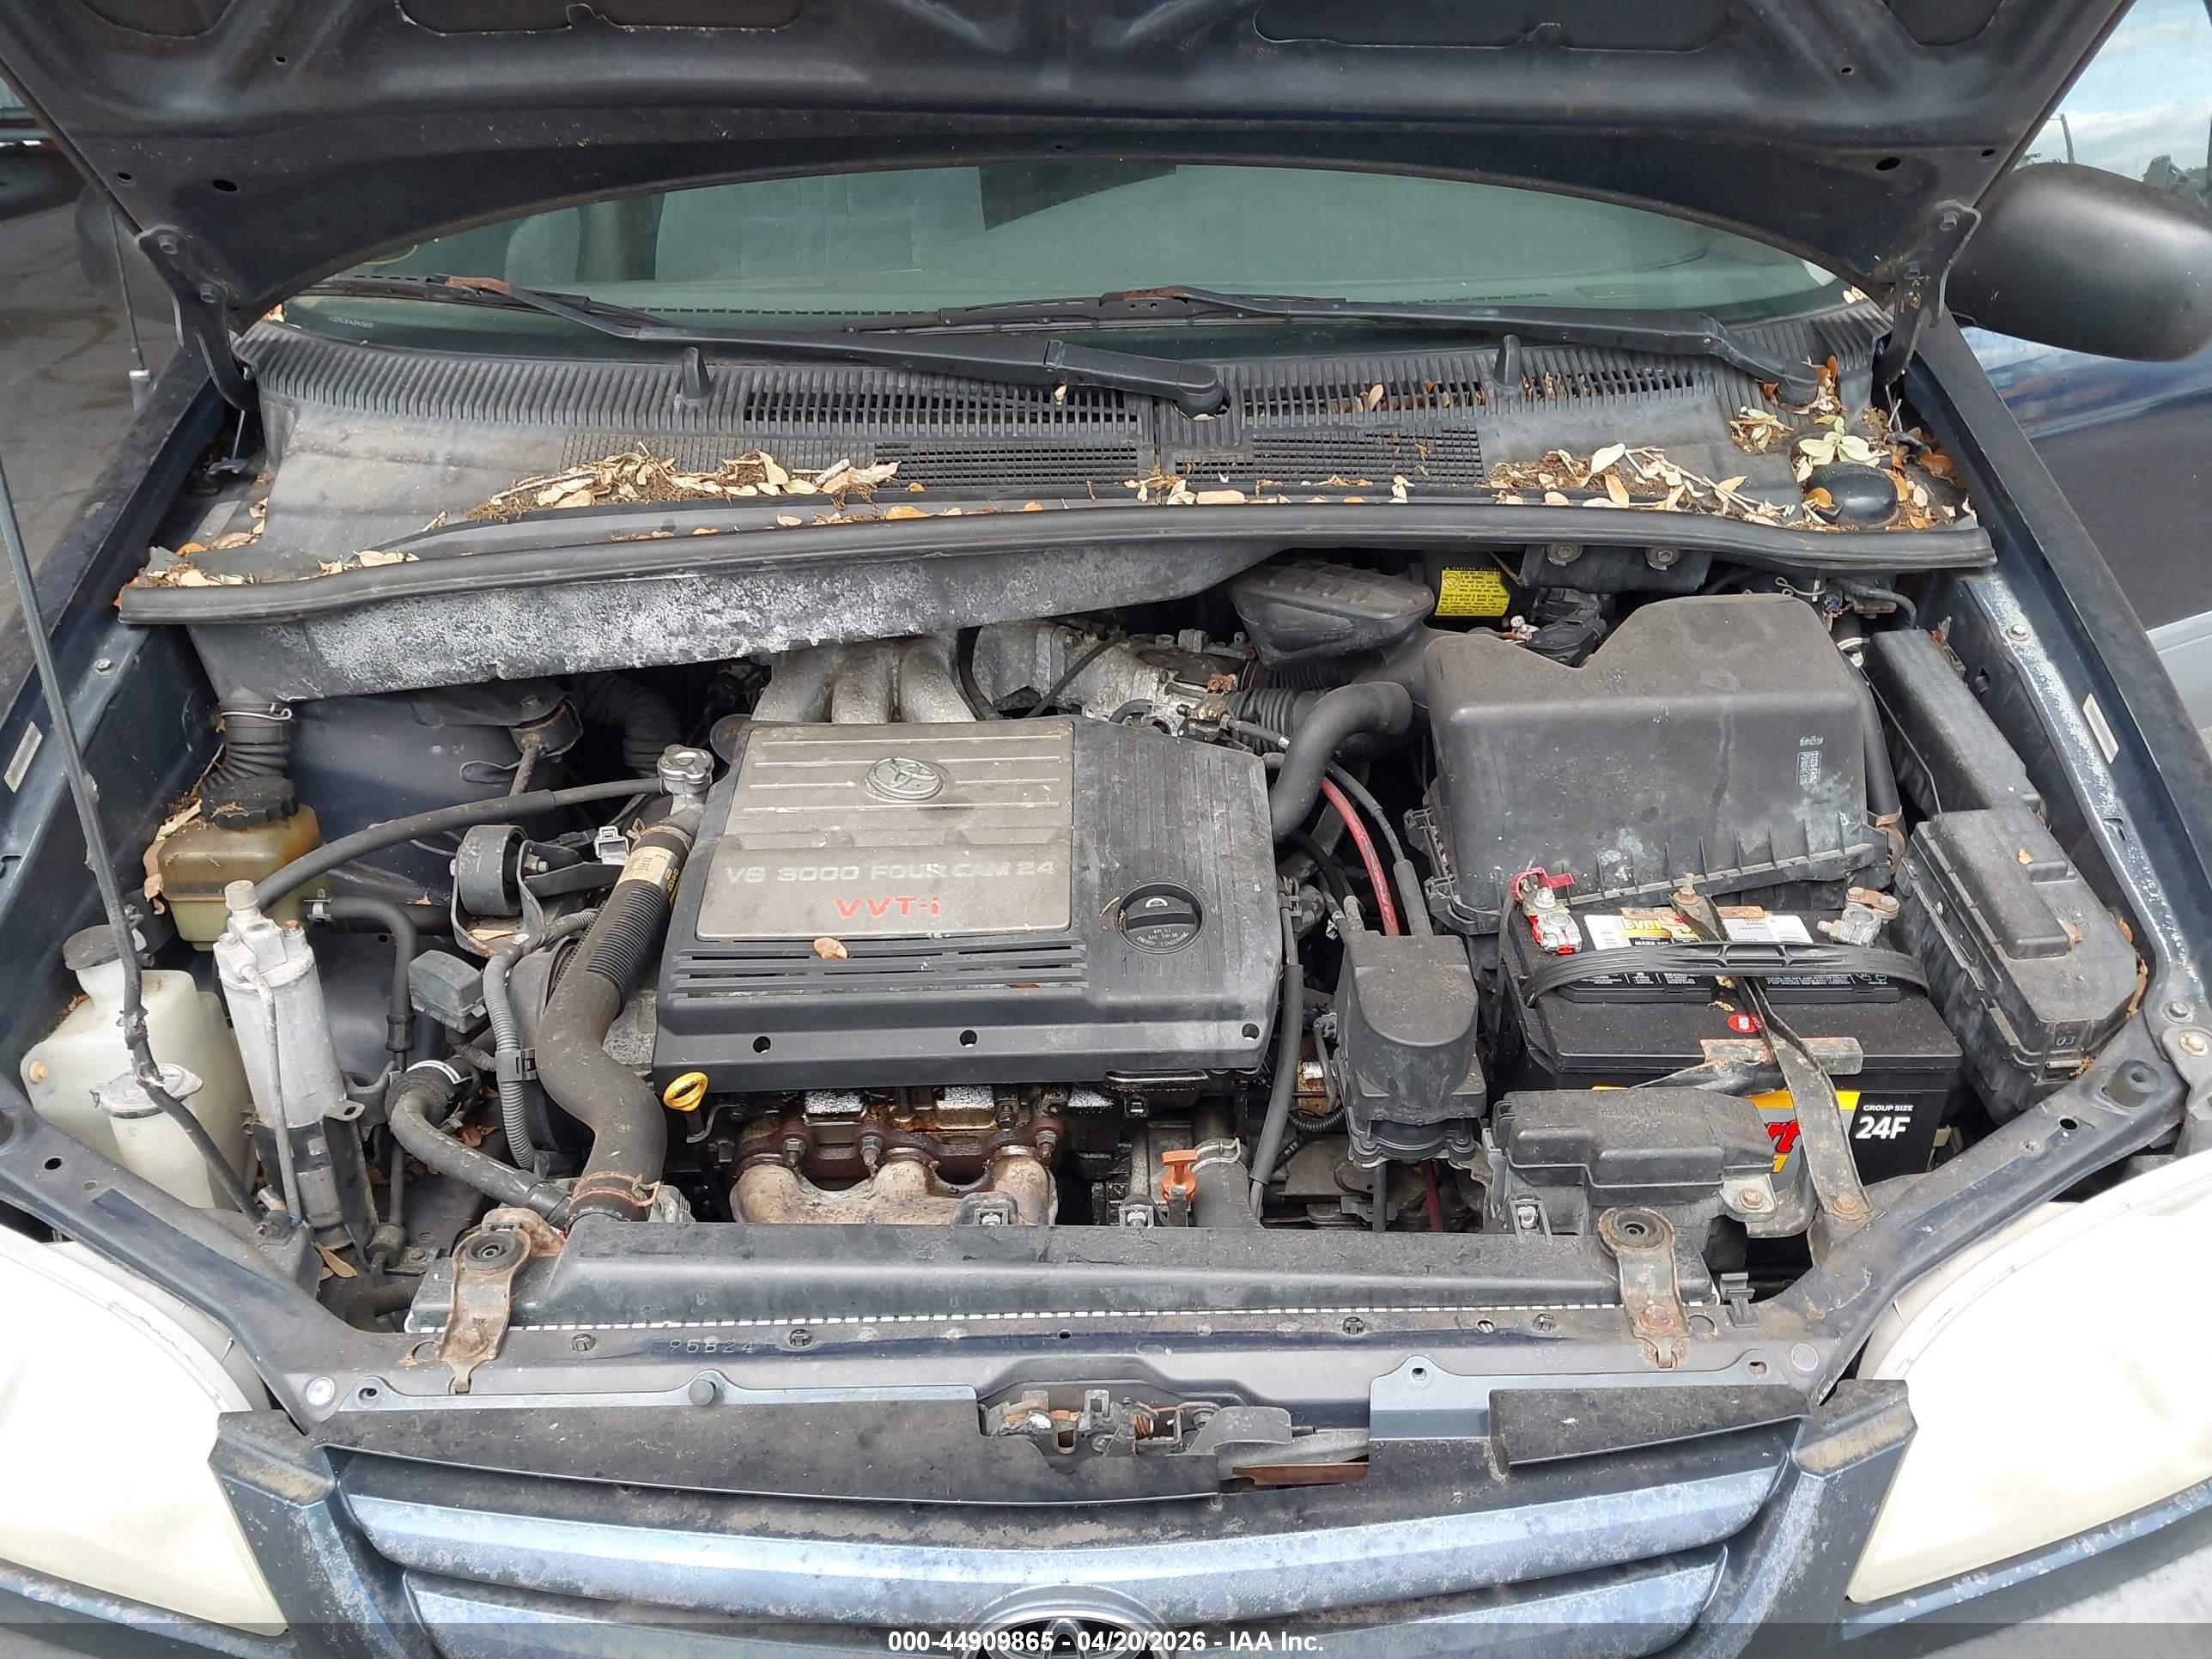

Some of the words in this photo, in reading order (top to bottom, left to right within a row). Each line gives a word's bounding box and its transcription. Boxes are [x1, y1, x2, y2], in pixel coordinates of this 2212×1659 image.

[726, 866, 767, 884] V6
[777, 866, 860, 882] 3000
[870, 862, 947, 881] FOUR
[1016, 860, 1057, 876] 24
[835, 895, 941, 919] VVT-i
[1863, 1103, 1893, 1112] GROUP
[1855, 1115, 1911, 1140] 24F
